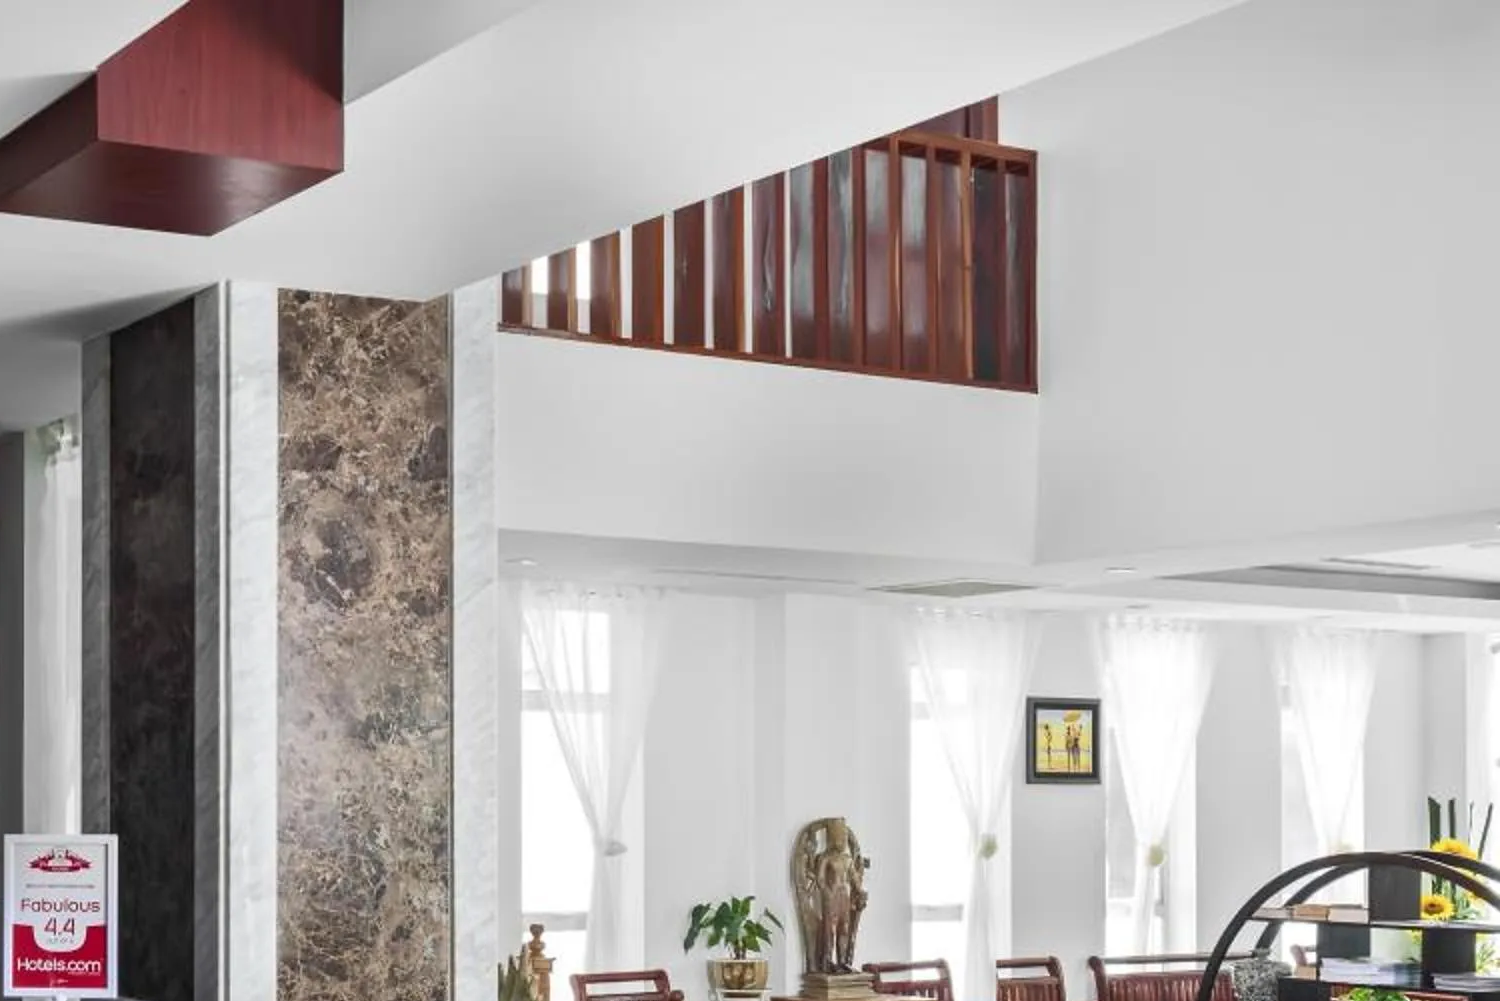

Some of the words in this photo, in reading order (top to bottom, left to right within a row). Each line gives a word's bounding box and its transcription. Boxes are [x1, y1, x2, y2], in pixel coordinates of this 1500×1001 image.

[20, 899, 101, 913] Fabulous
[43, 917, 76, 936] 4.4
[16, 956, 103, 974] Hotels.com
